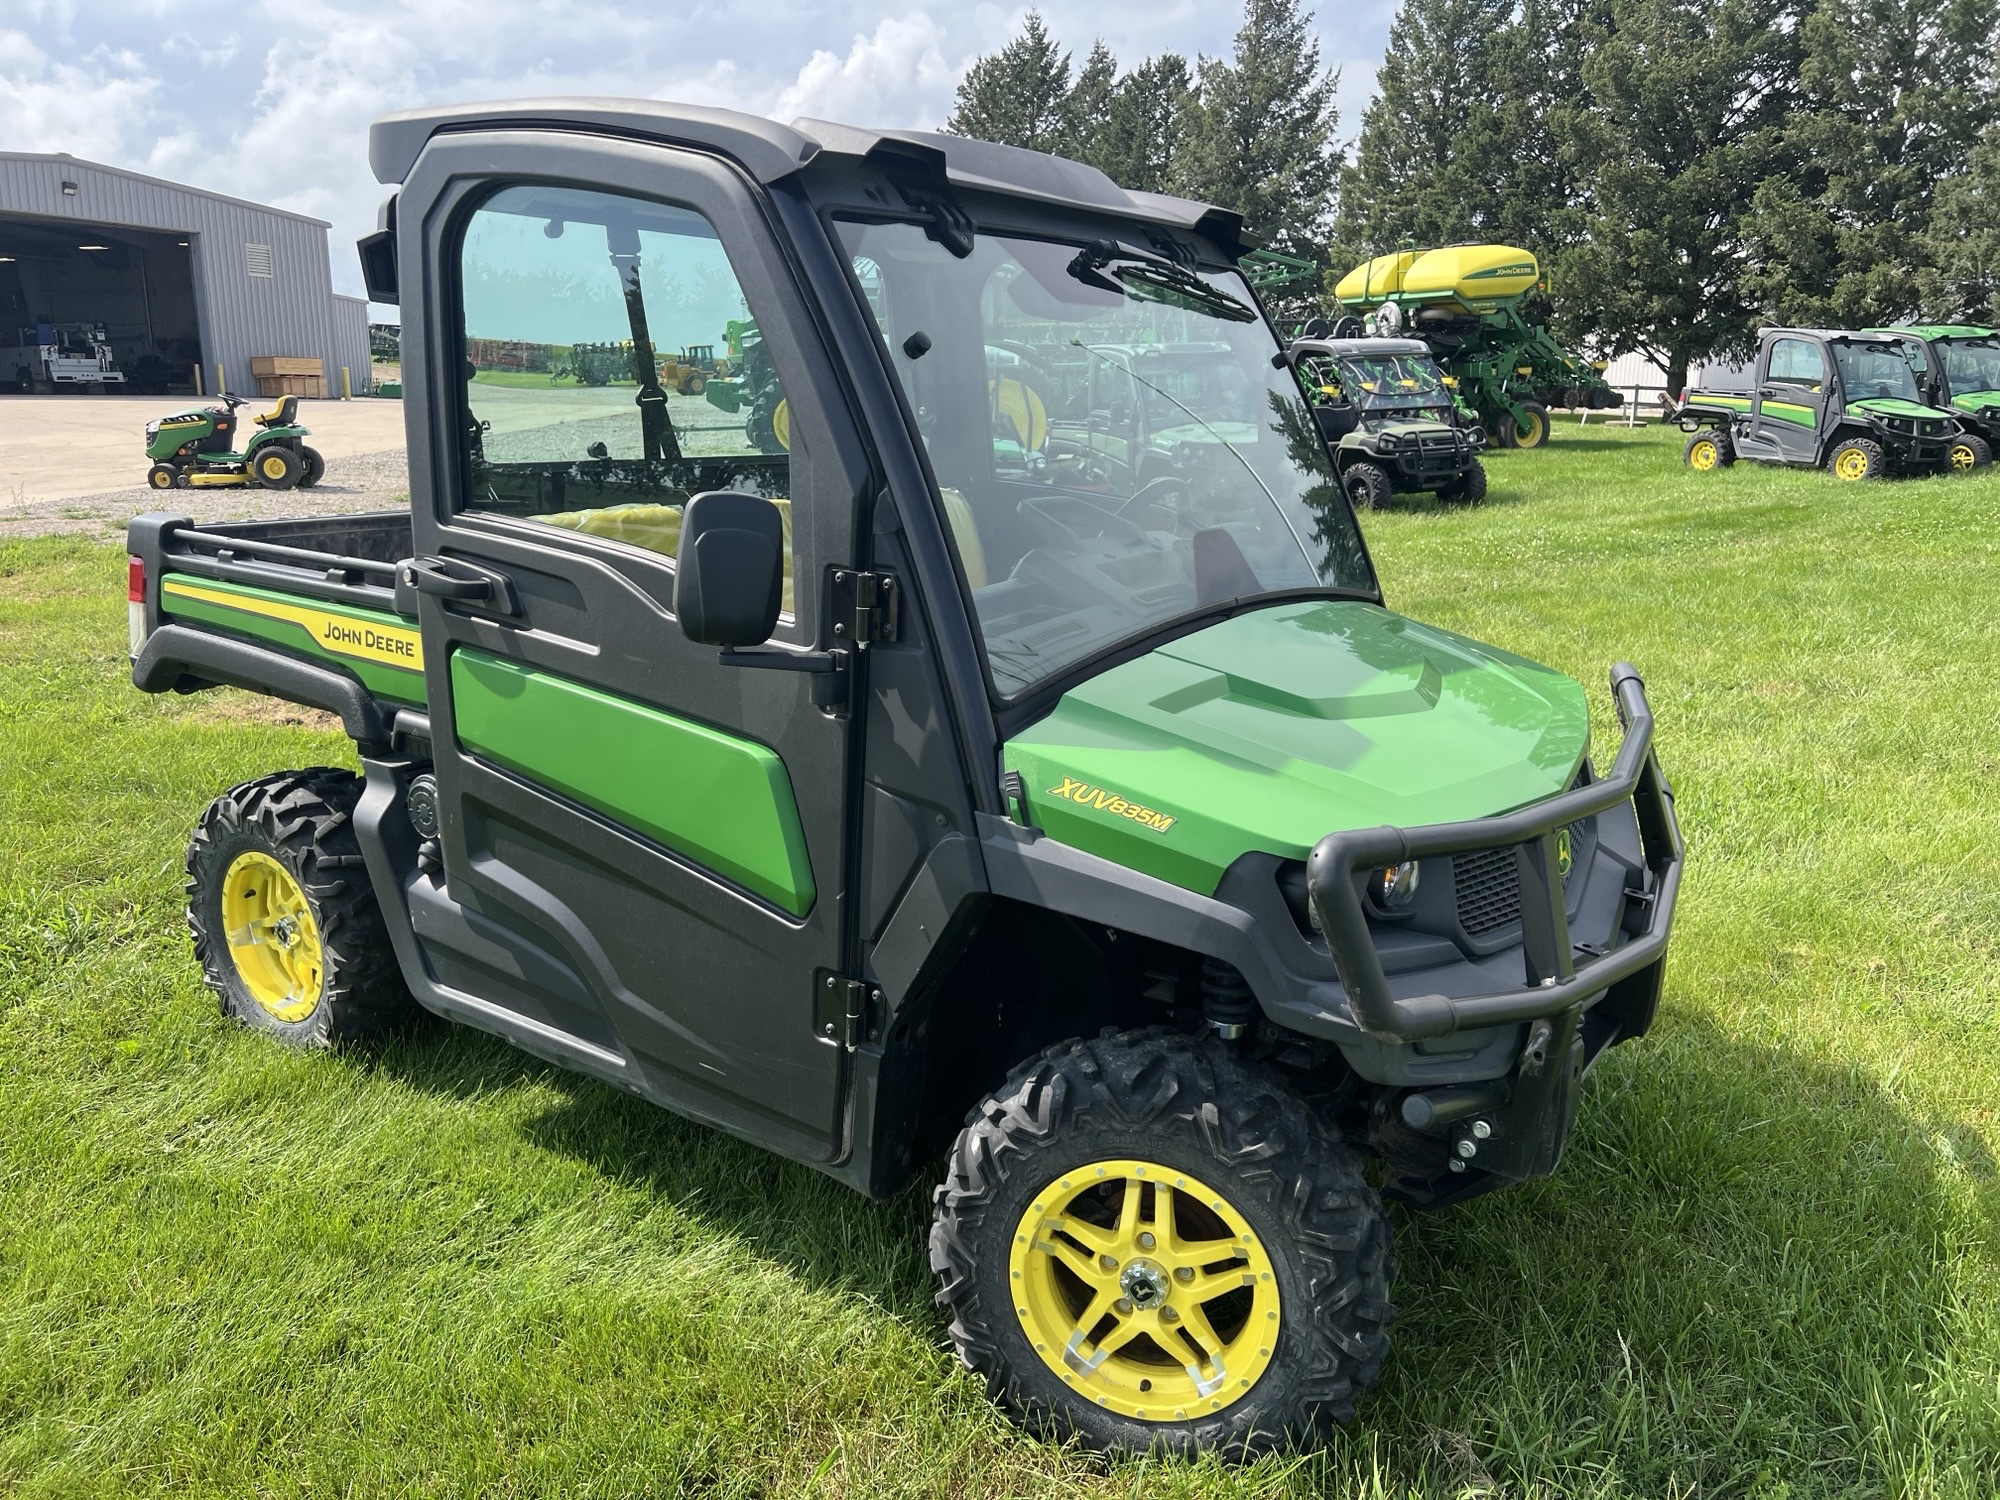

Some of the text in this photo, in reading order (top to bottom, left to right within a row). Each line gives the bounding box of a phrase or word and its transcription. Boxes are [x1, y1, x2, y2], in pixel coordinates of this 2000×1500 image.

[324, 622, 414, 657] JOHN DEERE
[1049, 777, 1176, 832] XUV835M
